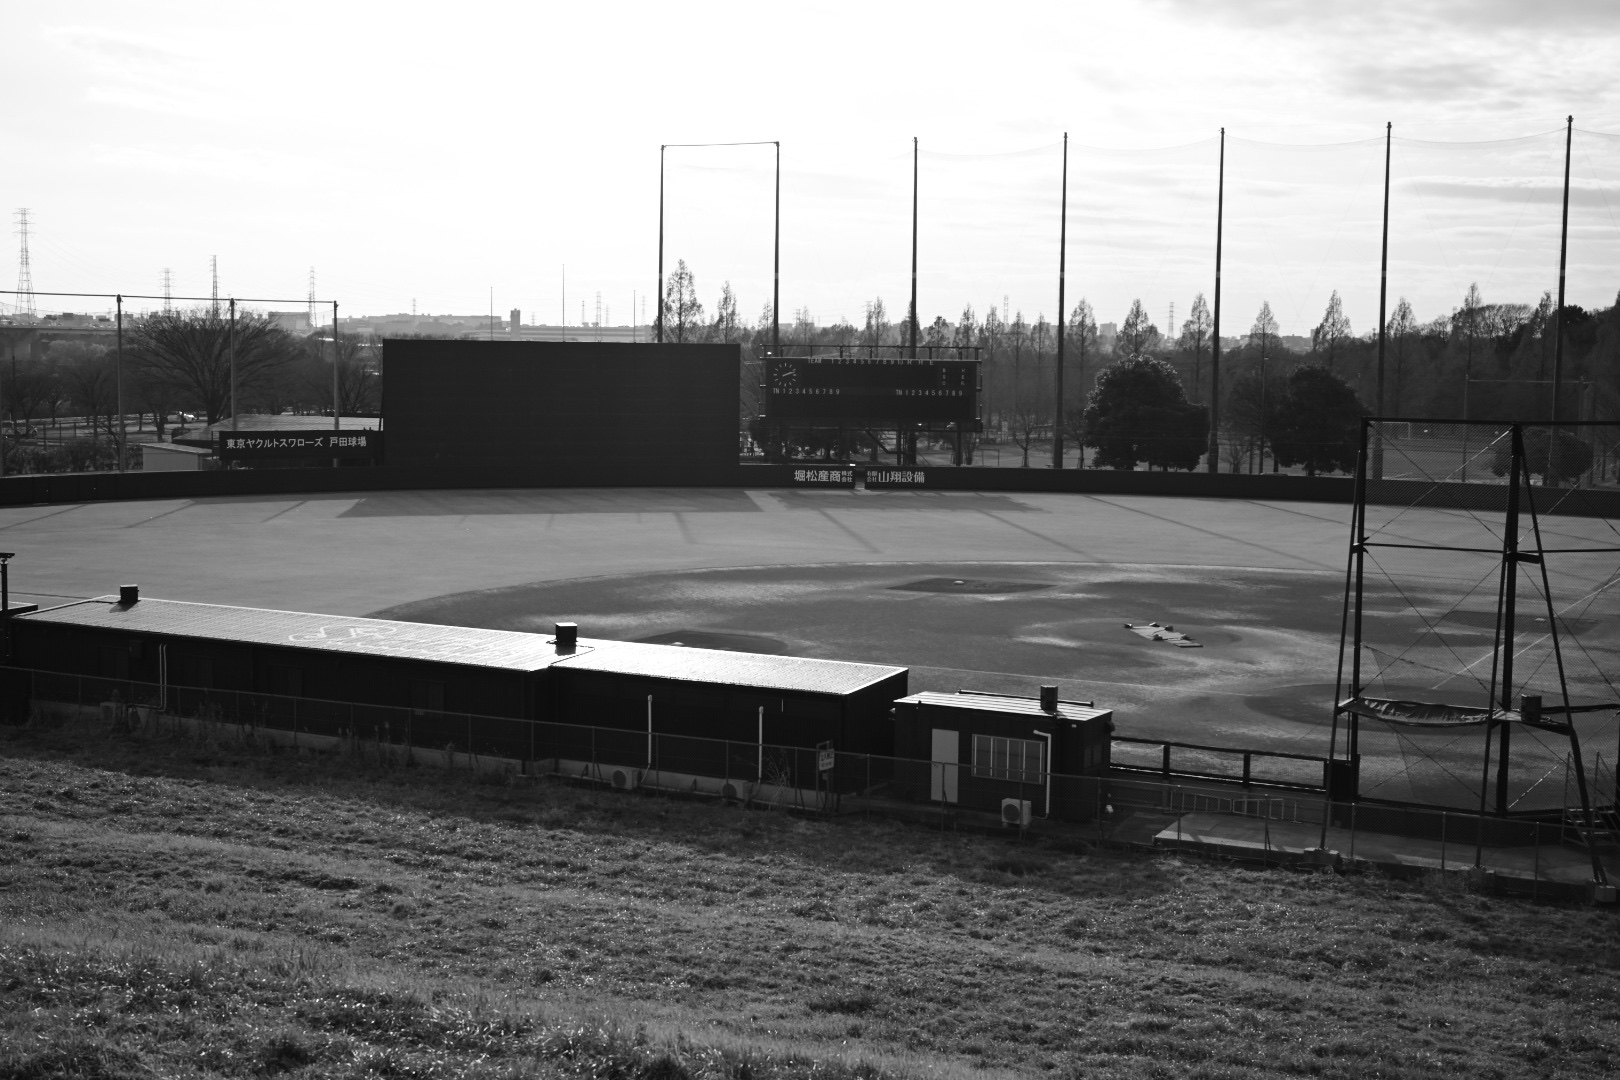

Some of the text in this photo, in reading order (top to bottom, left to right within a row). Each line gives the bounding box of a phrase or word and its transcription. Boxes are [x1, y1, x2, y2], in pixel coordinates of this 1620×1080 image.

[226, 436, 367, 449] 東京ヤクルトスワローズ 戸田球場
